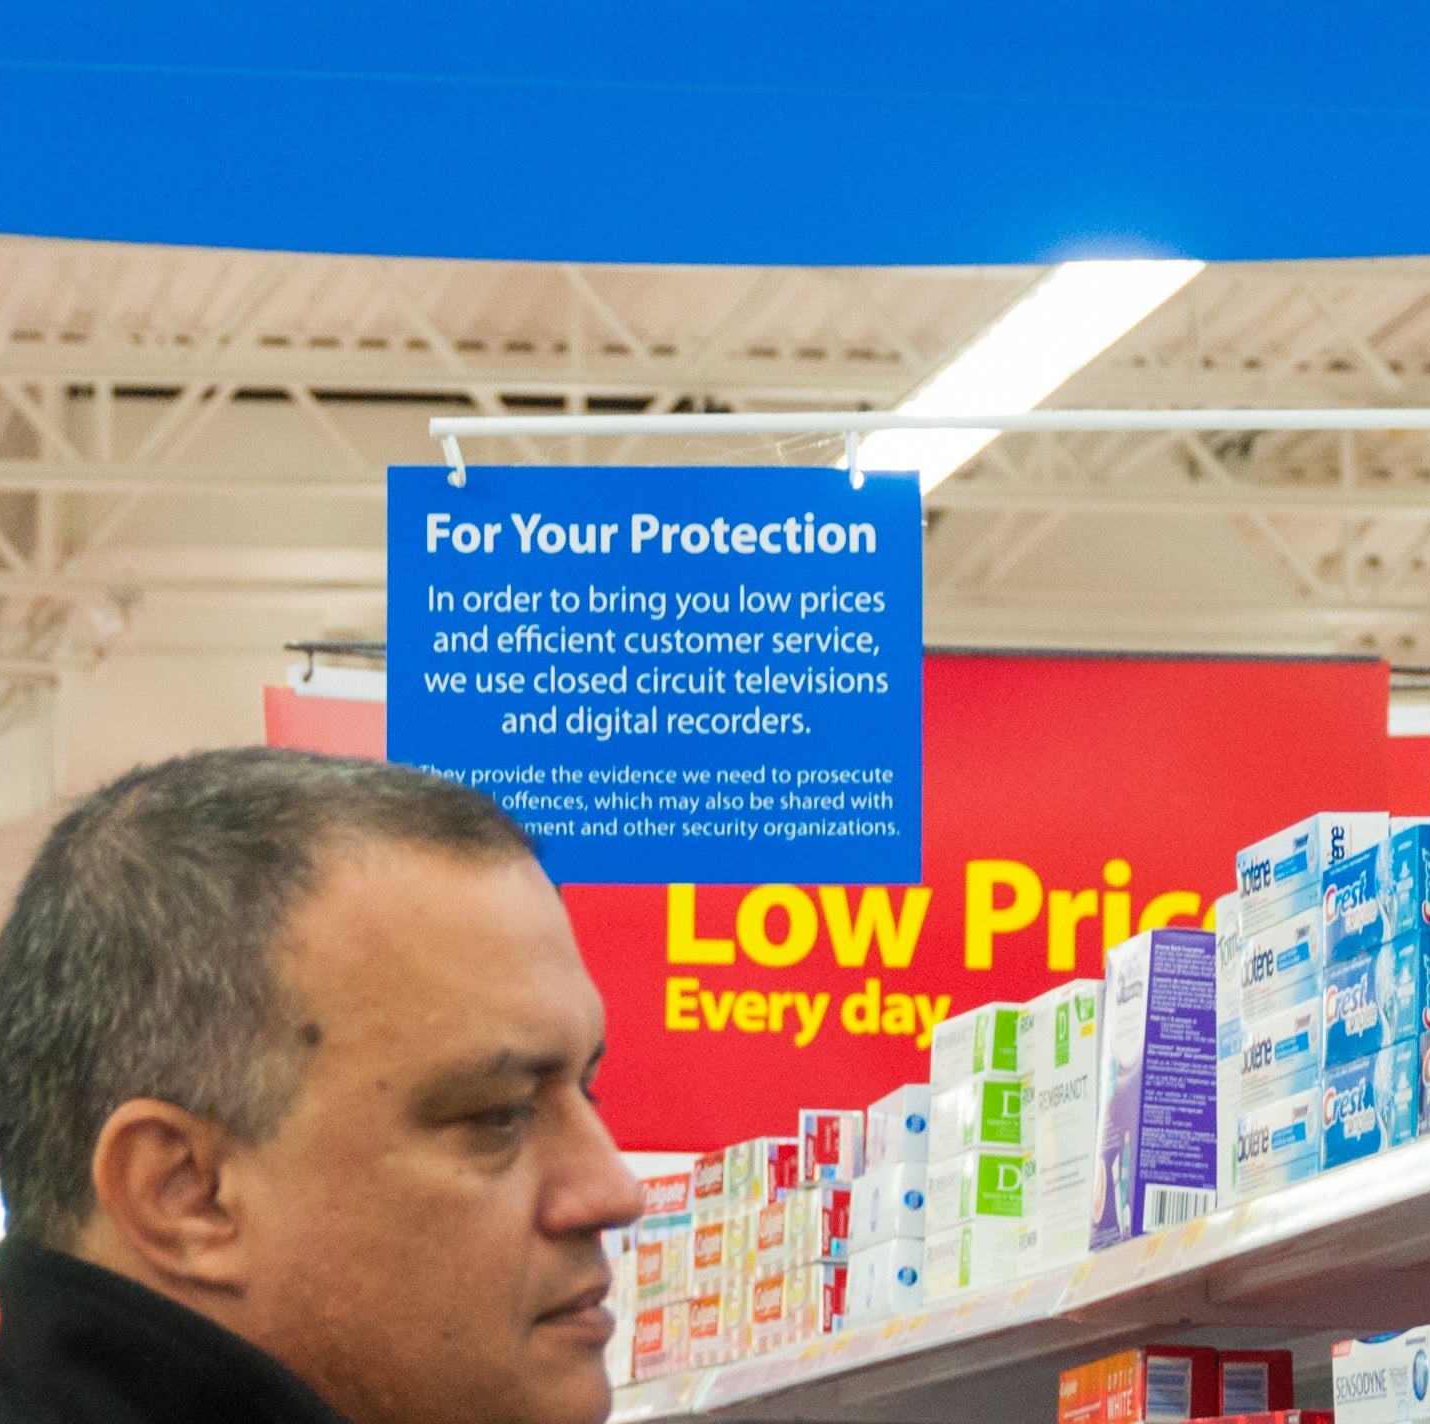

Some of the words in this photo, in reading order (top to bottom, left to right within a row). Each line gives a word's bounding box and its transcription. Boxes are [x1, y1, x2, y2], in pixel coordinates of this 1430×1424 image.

[426, 513, 502, 554] For
[511, 513, 619, 554] Your
[631, 511, 877, 554] Protection
[428, 585, 454, 612] In
[462, 584, 542, 612] order
[550, 589, 580, 613] to
[589, 584, 667, 620] bring
[675, 592, 730, 619] you
[739, 584, 792, 613] low
[800, 586, 885, 619] prices
[433, 625, 488, 653] and
[497, 624, 615, 653] efficient
[624, 630, 764, 653] customer
[772, 626, 879, 656] service,
[424, 672, 467, 693] we
[475, 673, 525, 693] use
[533, 665, 627, 694] closed
[636, 667, 726, 694] circuit
[734, 666, 889, 694] televisions
[501, 705, 557, 734] and
[565, 706, 657, 741] digital
[667, 706, 811, 734] recorders.
[471, 765, 546, 788] provide
[550, 766, 583, 784] the
[587, 766, 677, 784] evidence
[682, 771, 711, 784] we
[716, 766, 765, 784] need
[771, 768, 792, 784] to
[796, 768, 894, 788] prosecute
[501, 790, 589, 812] offences,
[593, 791, 654, 810] which
[658, 797, 699, 813] may
[704, 791, 744, 810] also
[749, 791, 775, 810] be
[779, 791, 846, 810] shared
[850, 791, 894, 810] with
[580, 818, 618, 836] and
[622, 818, 677, 836] other
[681, 819, 758, 841] security
[762, 819, 900, 841] organizations.
[1324, 870, 1368, 924] Crest
[665, 884, 932, 969] Low
[664, 977, 830, 1048] Every
[841, 977, 951, 1049] day
[1325, 975, 1368, 1027] Crest
[1038, 1075, 1088, 1114] REMBRANDT
[1323, 1077, 1368, 1128] Crest
[1335, 1368, 1387, 1399] SENSODYNE
[1107, 1390, 1134, 1421] WHITE
